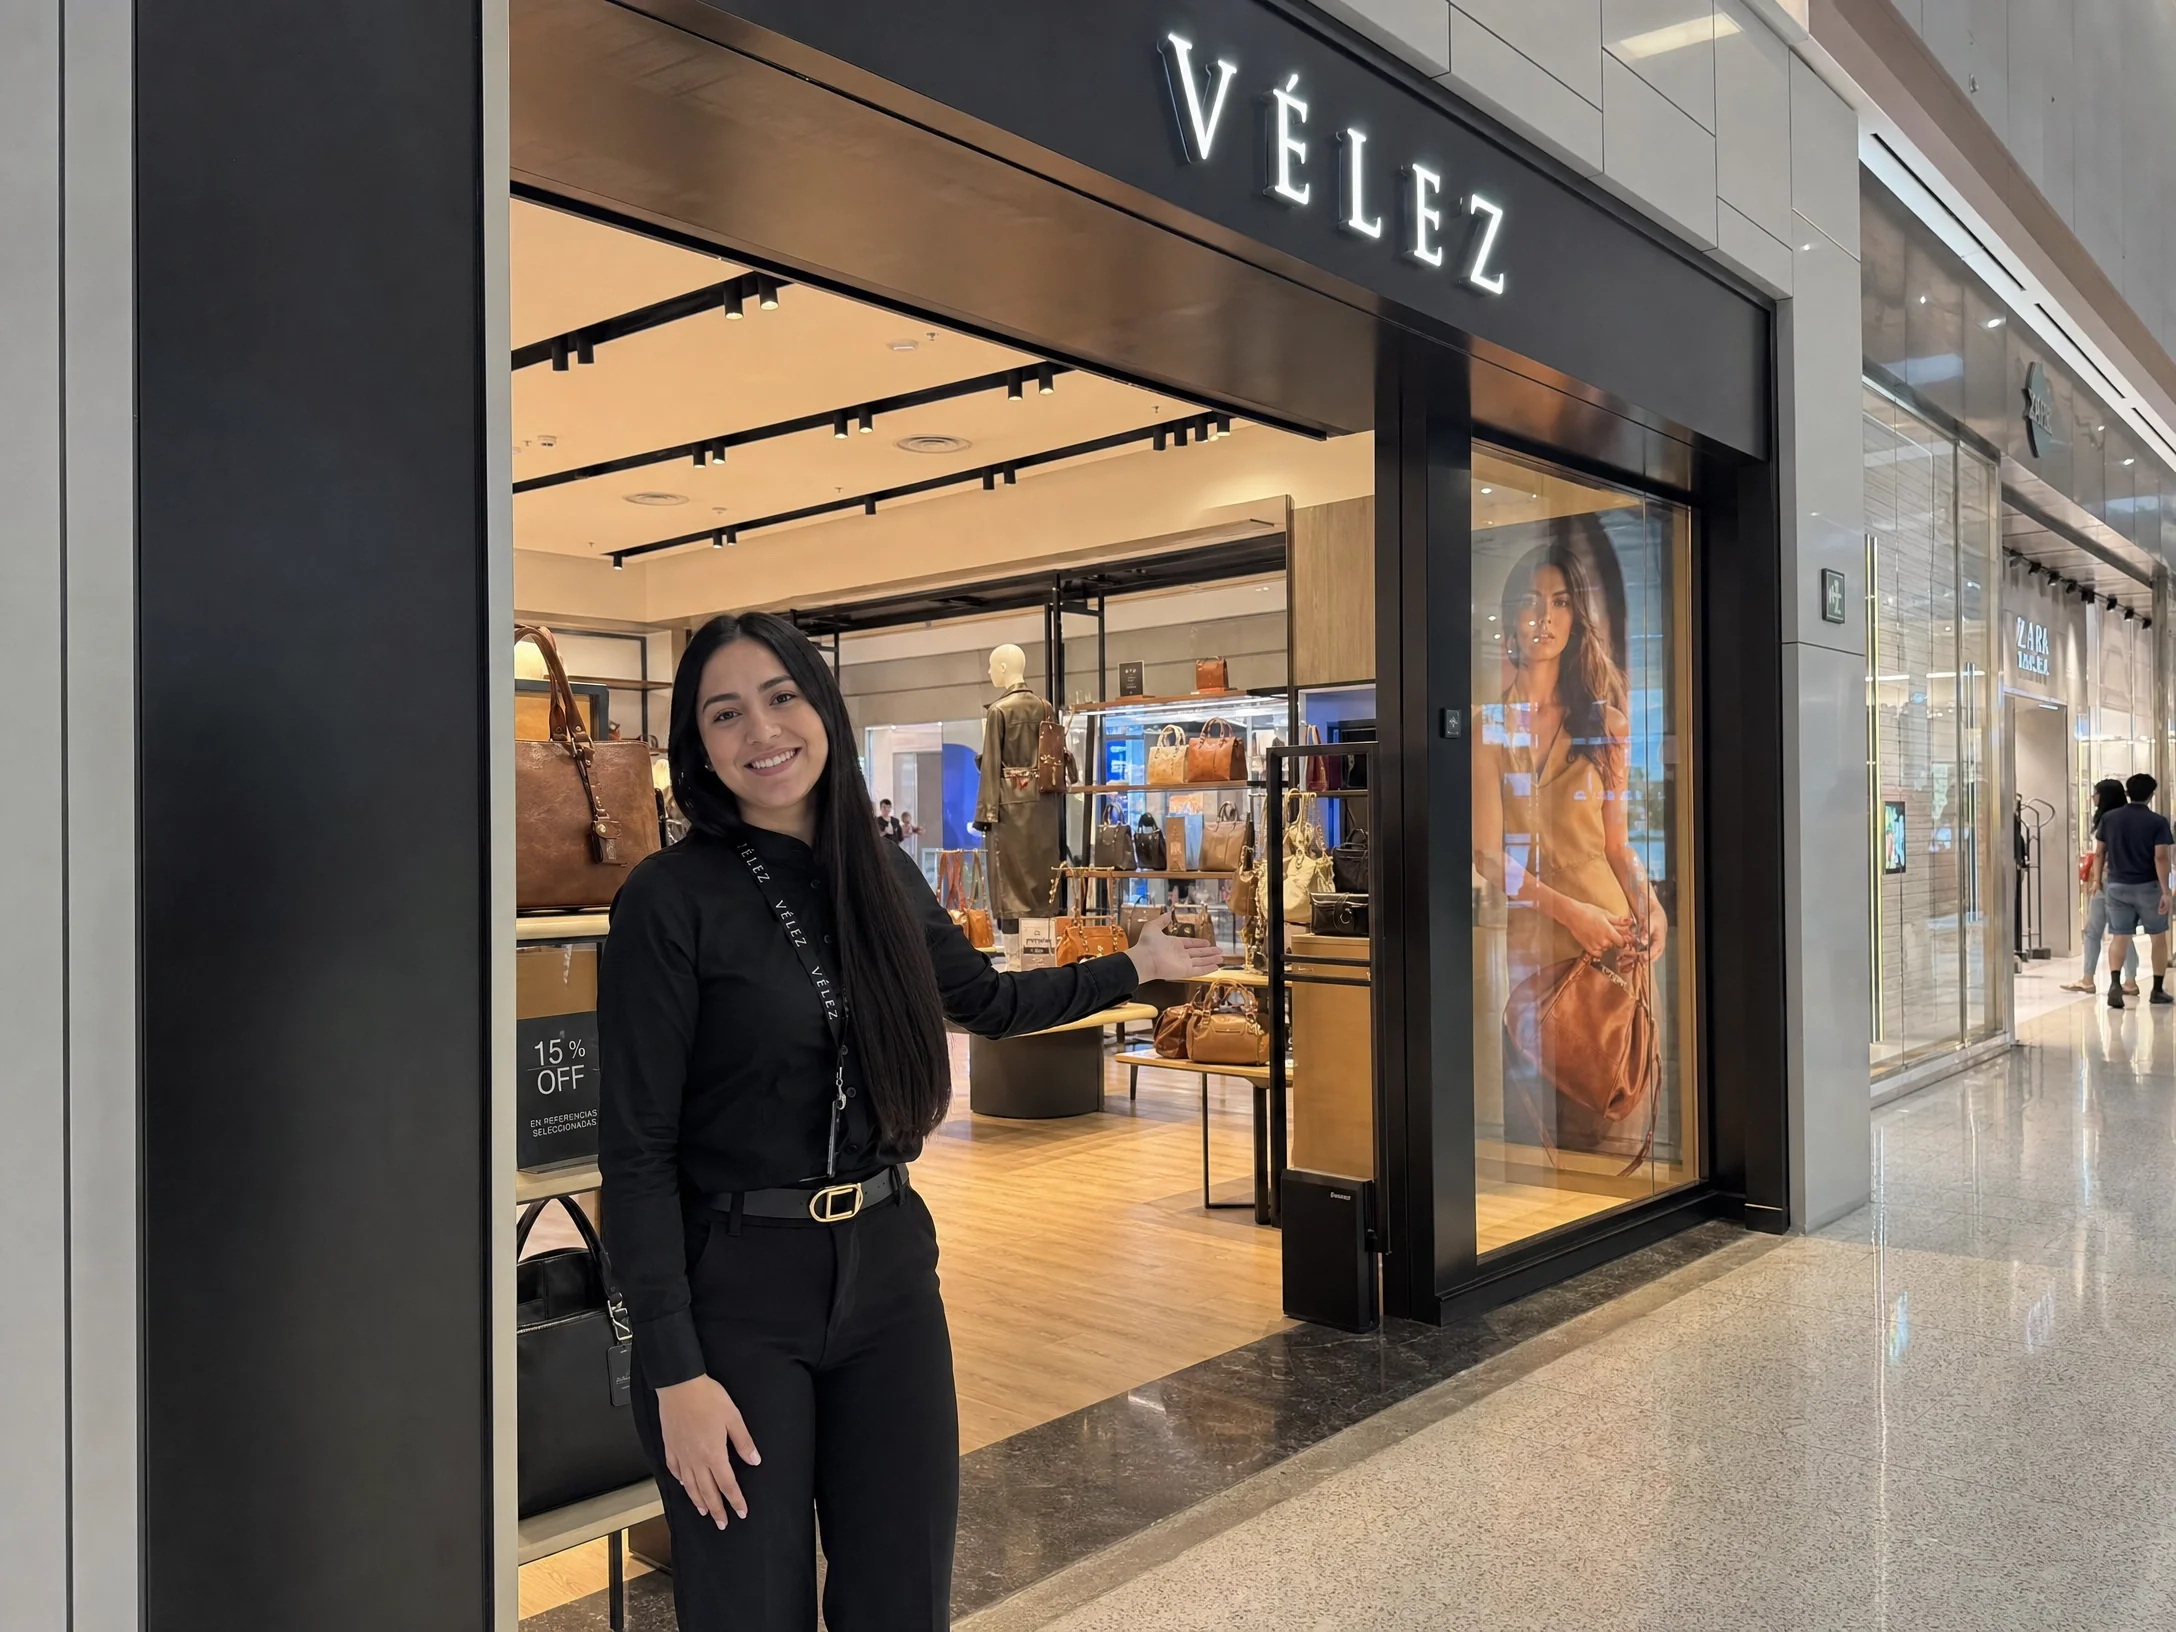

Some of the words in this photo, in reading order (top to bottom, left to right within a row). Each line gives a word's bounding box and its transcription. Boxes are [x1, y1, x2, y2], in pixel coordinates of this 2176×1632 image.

[1161, 31, 1505, 296] VÉLEZ
[775, 899, 807, 947] VÉLEZ
[811, 966, 838, 1020] VÉLEZ
[534, 1038, 563, 1066] 15
[568, 1038, 586, 1059] %
[537, 1064, 585, 1095] OFF
[530, 1119, 542, 1128] EN
[543, 1108, 598, 1125] REFERENCIAS
[532, 1118, 597, 1138] SELECCIONADAS
